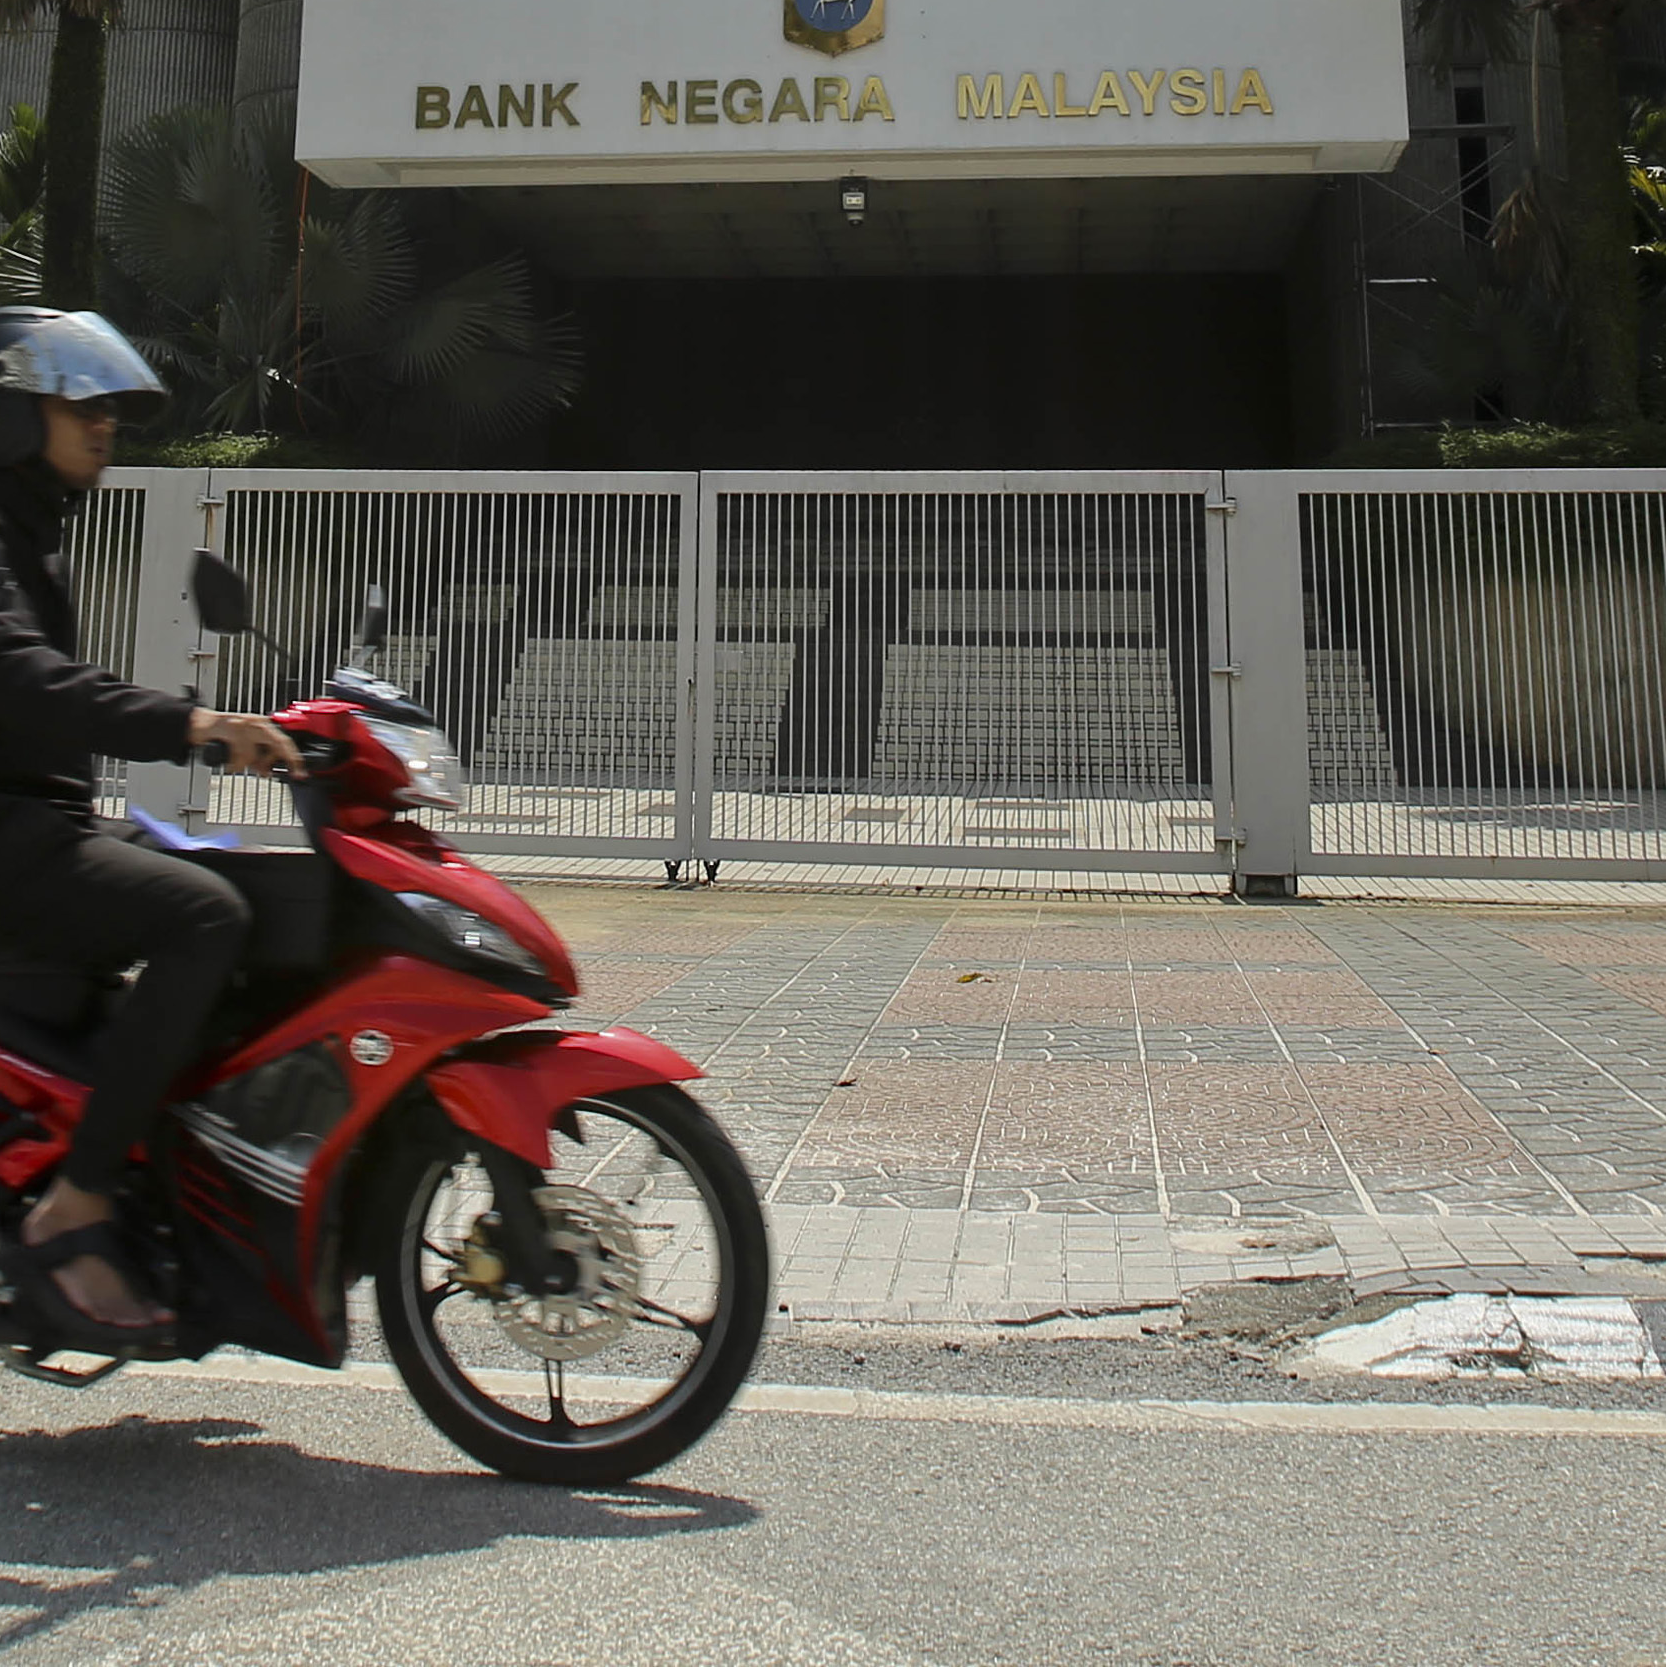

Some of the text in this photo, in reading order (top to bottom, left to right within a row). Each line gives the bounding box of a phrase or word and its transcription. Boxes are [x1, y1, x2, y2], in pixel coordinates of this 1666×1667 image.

[415, 67, 1274, 130] BANK NEGARA MALAYSIA
